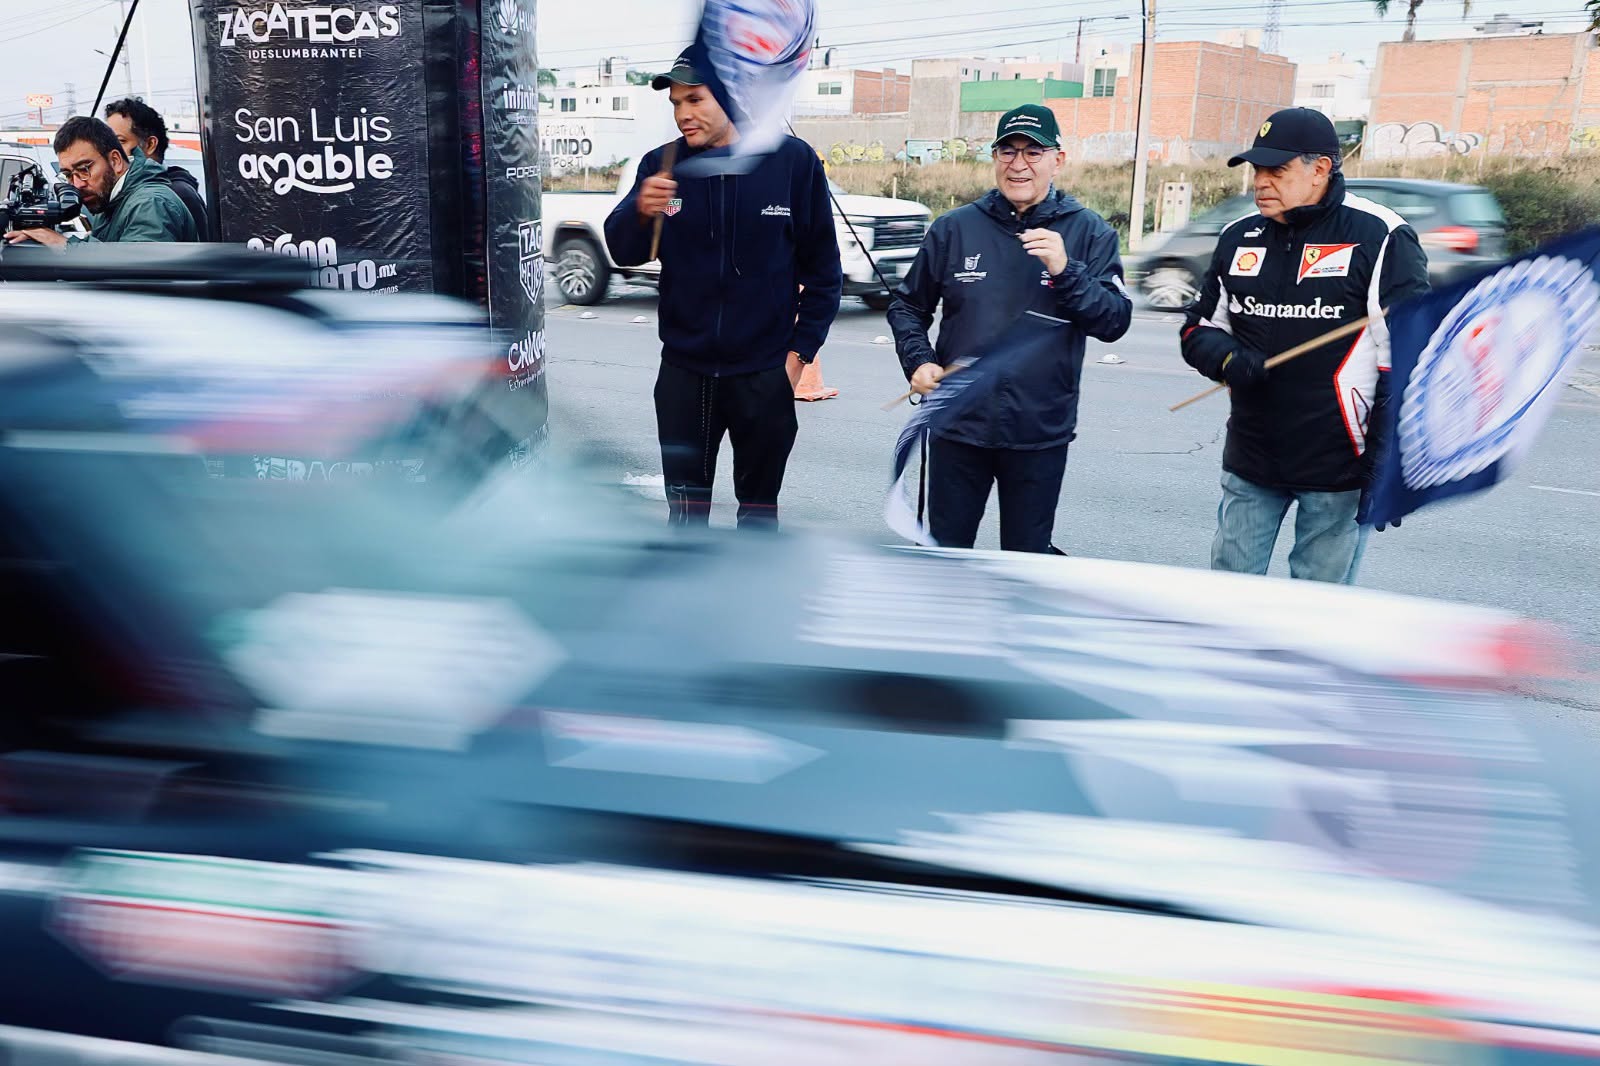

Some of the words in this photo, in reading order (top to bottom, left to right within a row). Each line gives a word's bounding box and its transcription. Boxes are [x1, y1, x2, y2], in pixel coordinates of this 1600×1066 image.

[218, 3, 400, 46] ZACATECAS
[235, 107, 300, 142] San
[311, 106, 393, 142] Luis
[238, 145, 394, 196] amable
[521, 225, 541, 254] TAG
[1243, 296, 1345, 320] Santander
